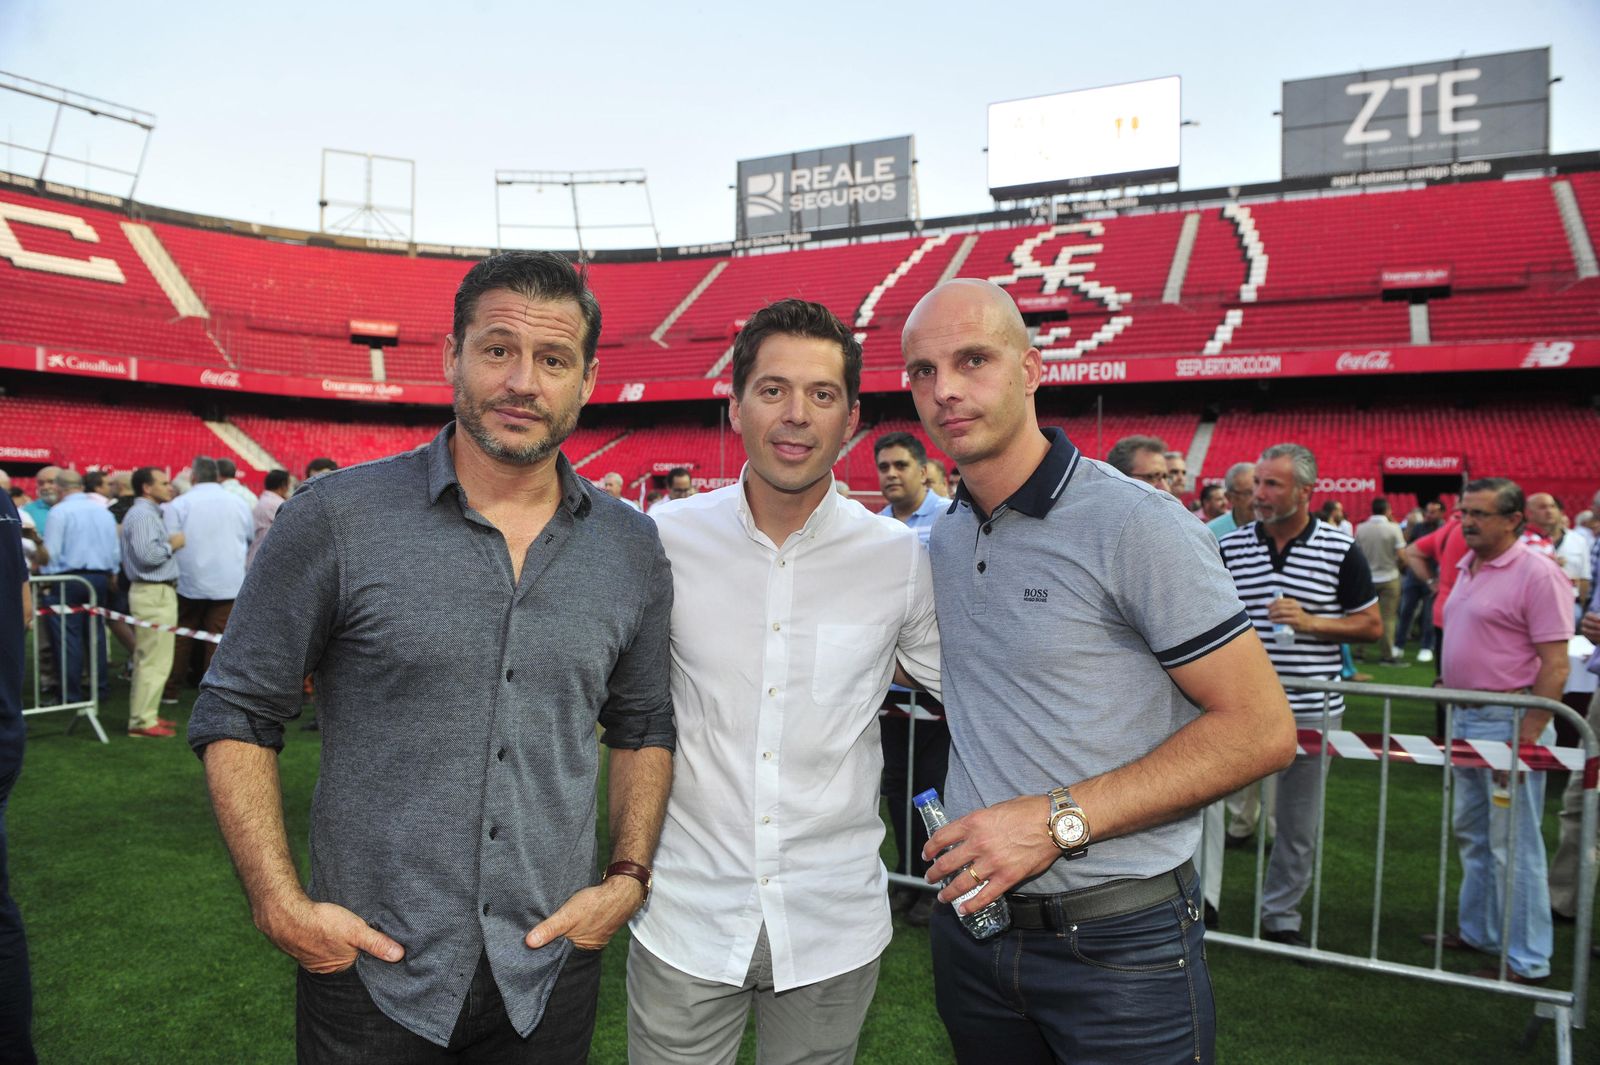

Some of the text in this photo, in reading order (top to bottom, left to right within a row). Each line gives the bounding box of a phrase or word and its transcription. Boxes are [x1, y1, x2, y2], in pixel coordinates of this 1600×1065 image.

[1343, 68, 1481, 145] ZTE
[790, 156, 895, 193] REALE
[789, 182, 896, 212] SEGUROS
[1385, 456, 1459, 469] CORDIALITY
[1024, 588, 1048, 598] BOSS
